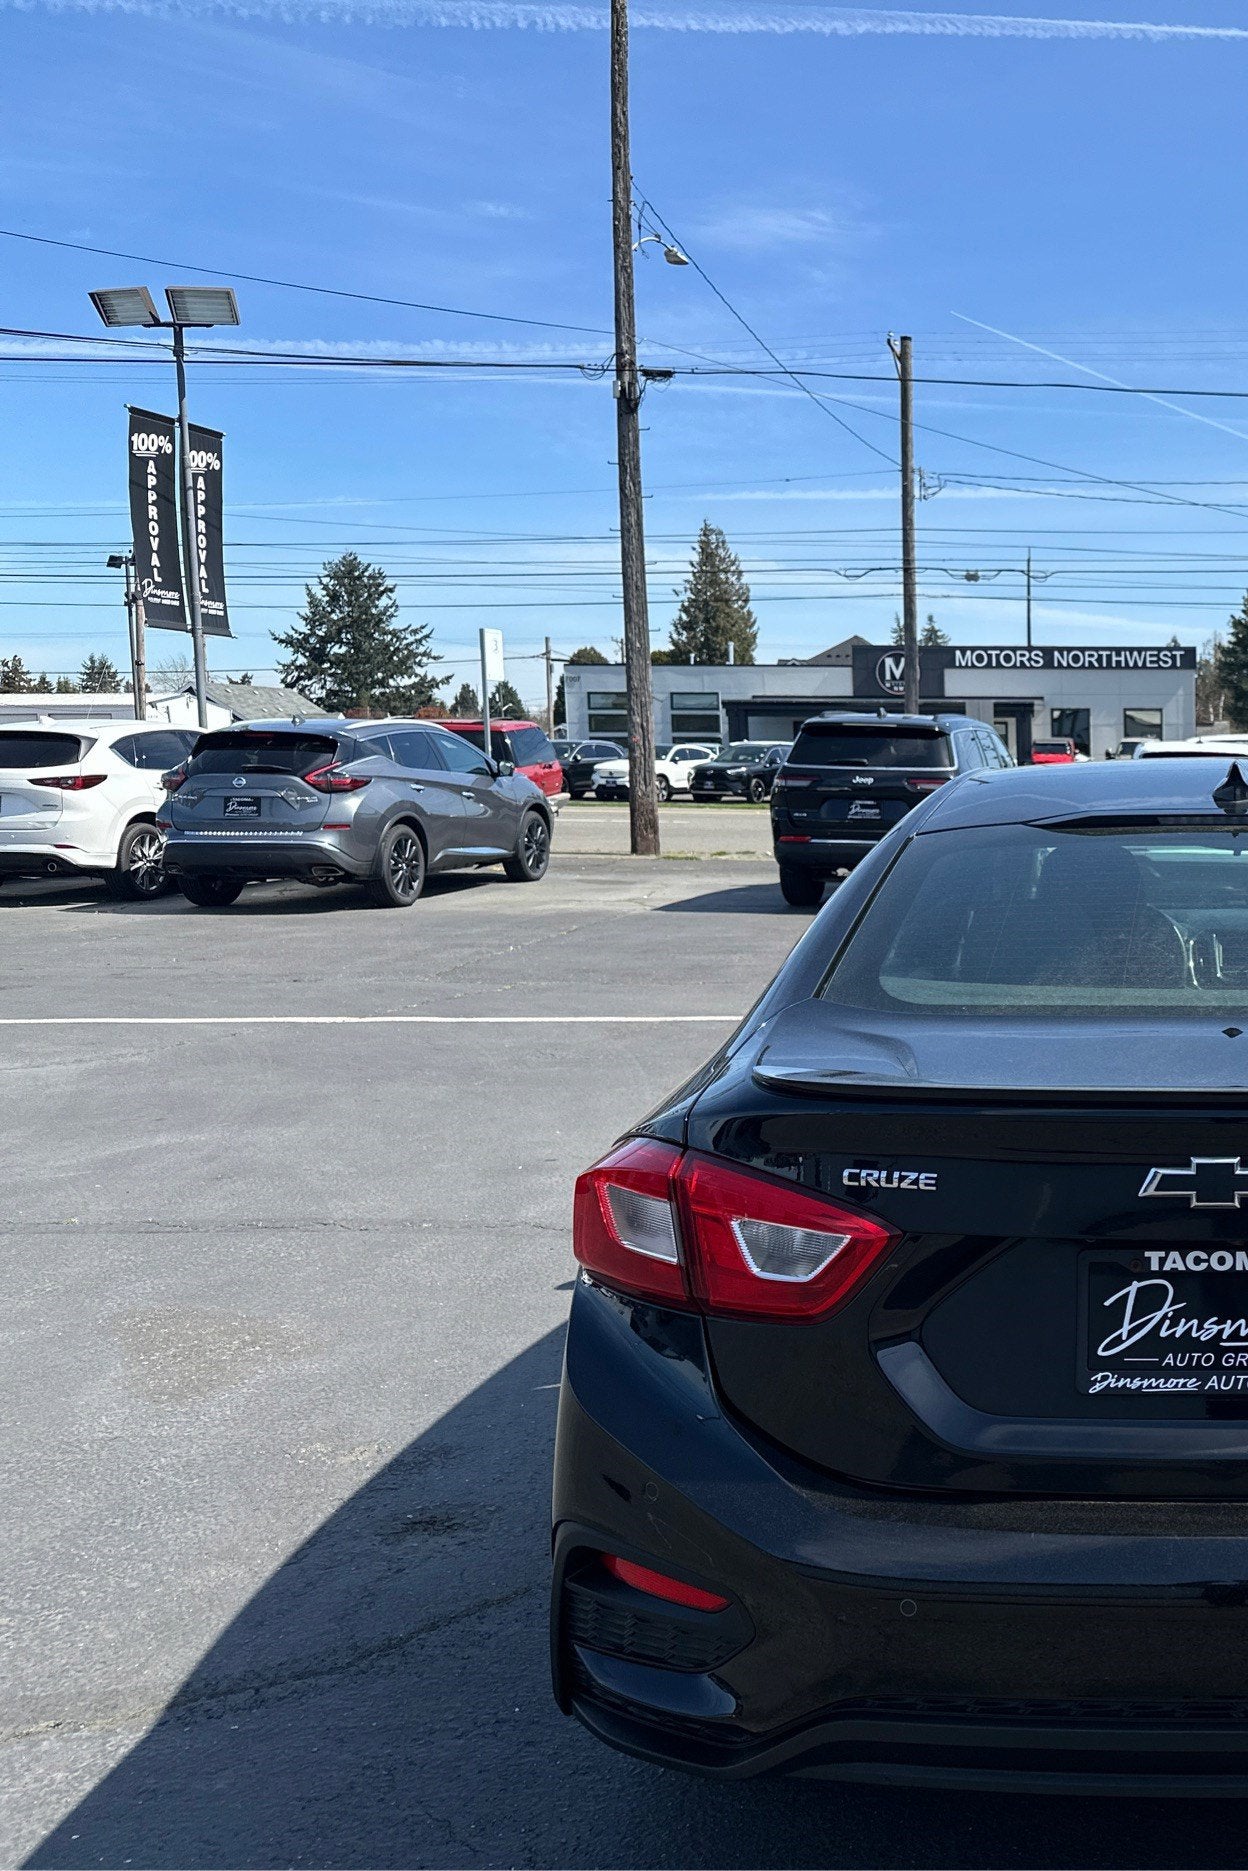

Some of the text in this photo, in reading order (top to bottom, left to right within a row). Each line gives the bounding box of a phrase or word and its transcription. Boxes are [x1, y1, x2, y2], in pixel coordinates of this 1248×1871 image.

[130, 432, 173, 455] 100%
[189, 450, 221, 471] 00%
[146, 459, 163, 583] APPROVAL
[196, 475, 210, 594] APPROVAL
[954, 649, 1185, 668] MOTORS NORTHWEST
[851, 776, 875, 786] Jeep
[842, 1168, 938, 1191] CRUZE
[1161, 1352, 1215, 1367] AUTO
[1088, 1372, 1202, 1394] Dinsmore
